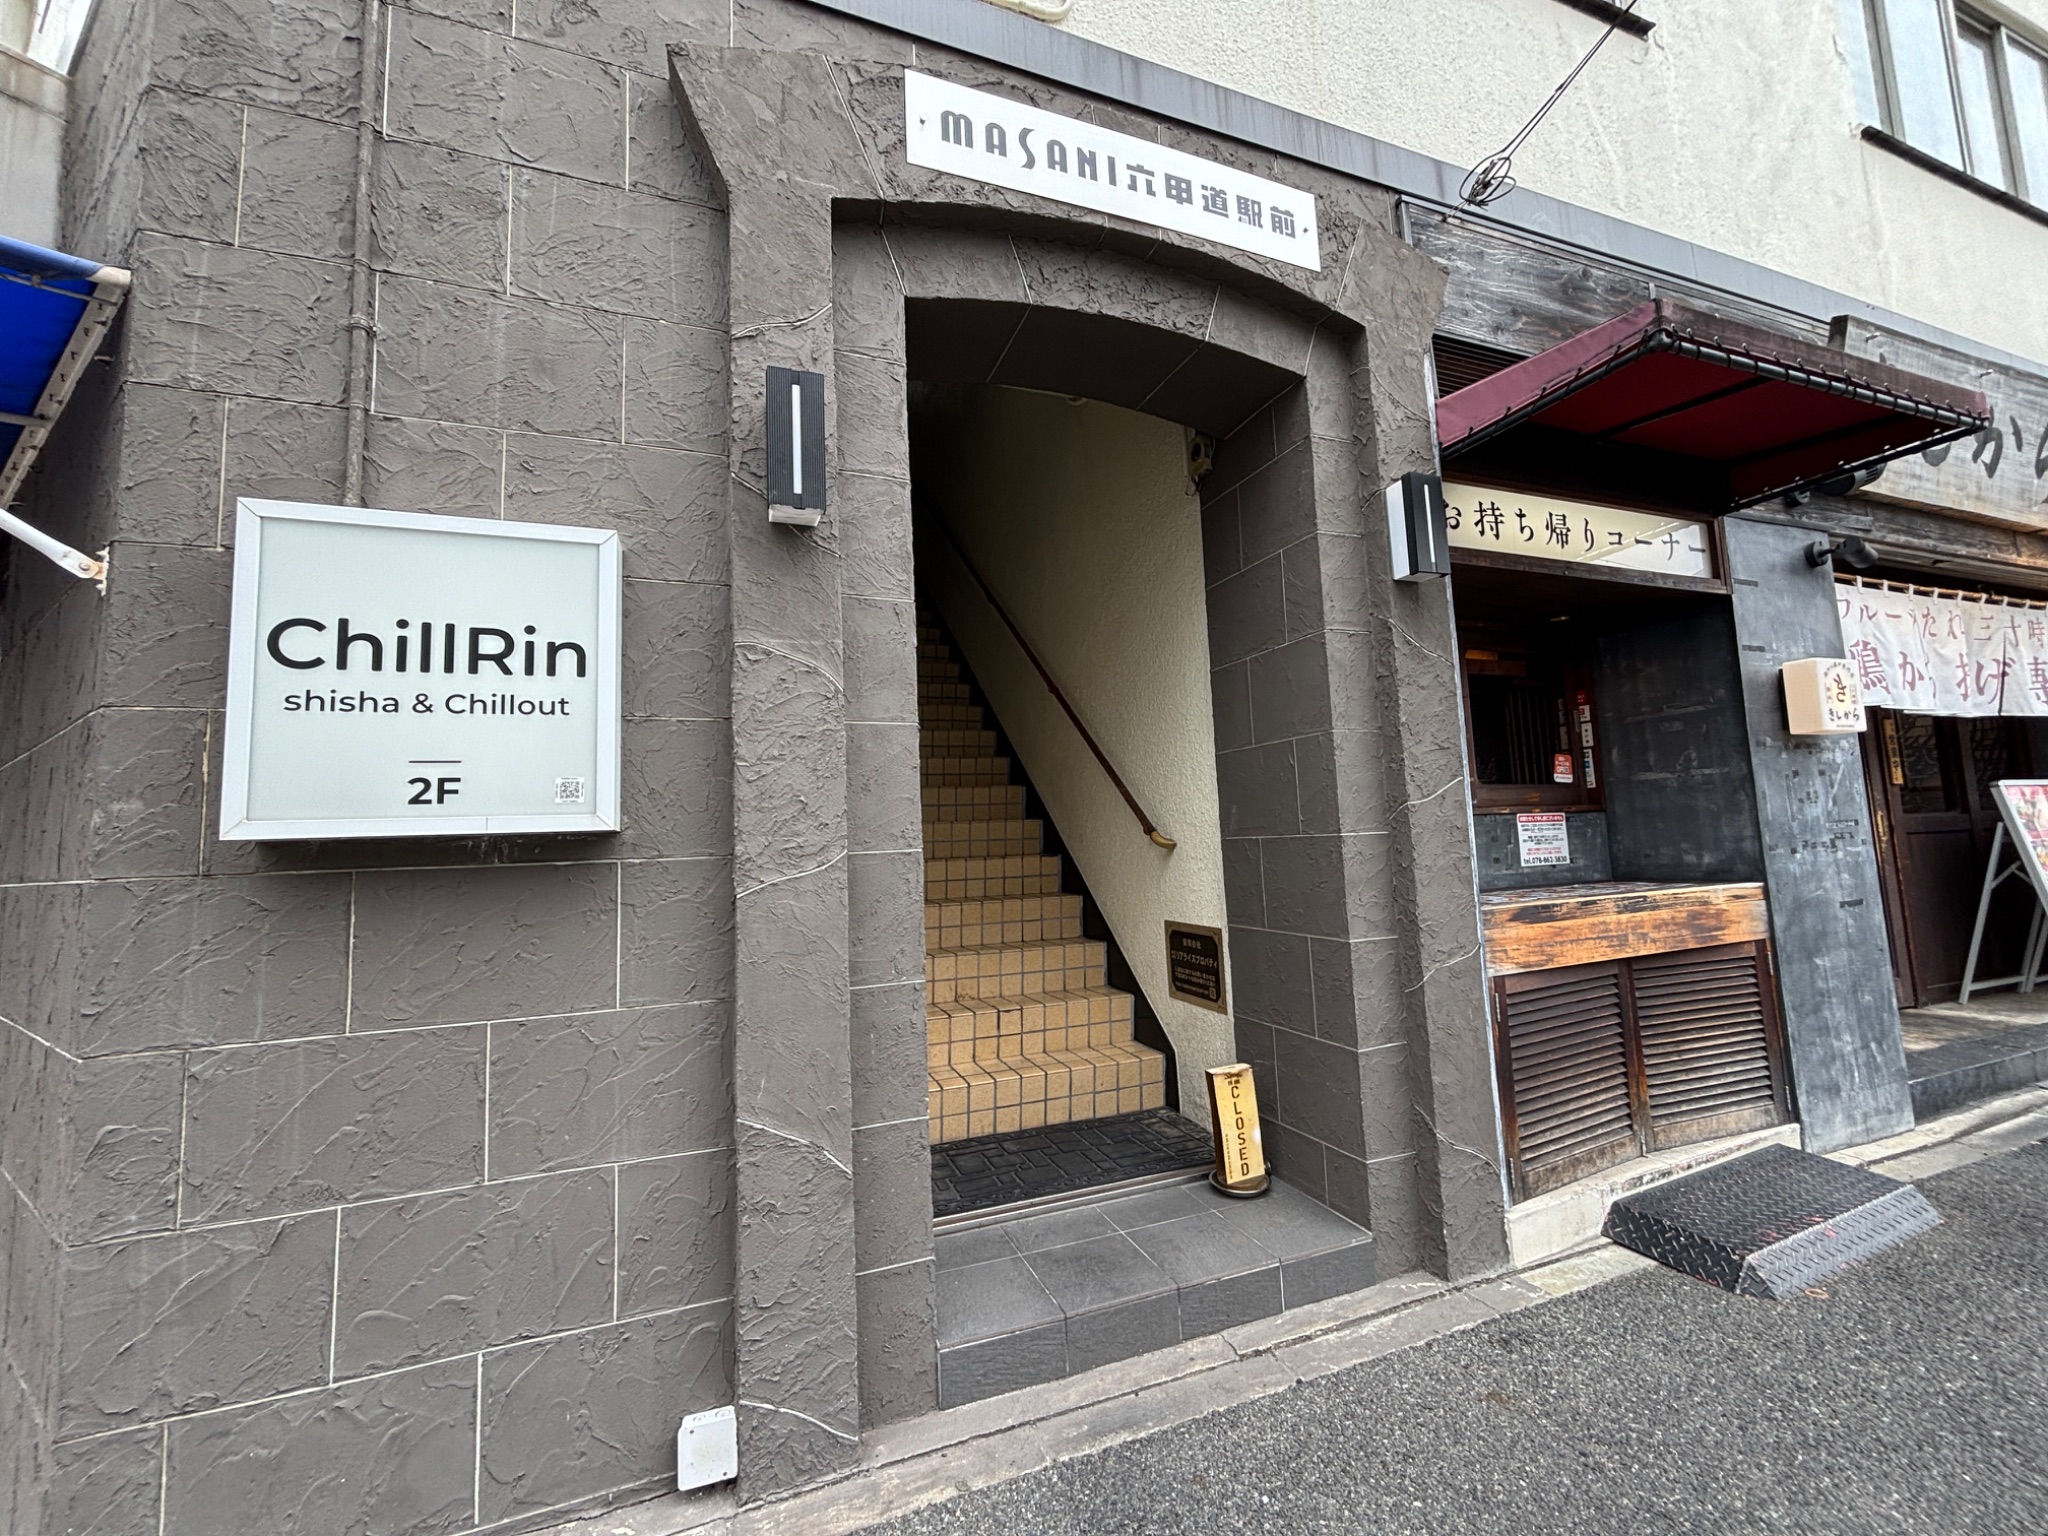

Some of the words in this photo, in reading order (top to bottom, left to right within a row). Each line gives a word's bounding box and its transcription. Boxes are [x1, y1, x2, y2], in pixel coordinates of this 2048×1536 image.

[1443, 498, 1706, 561] お持ち帰りコーナー
[266, 617, 587, 678] ChillRin
[283, 689, 400, 714] shisha
[411, 692, 434, 715] &
[444, 693, 570, 716] Chillout
[407, 776, 462, 805] 2F
[1231, 1085, 1250, 1178] CLOSED
